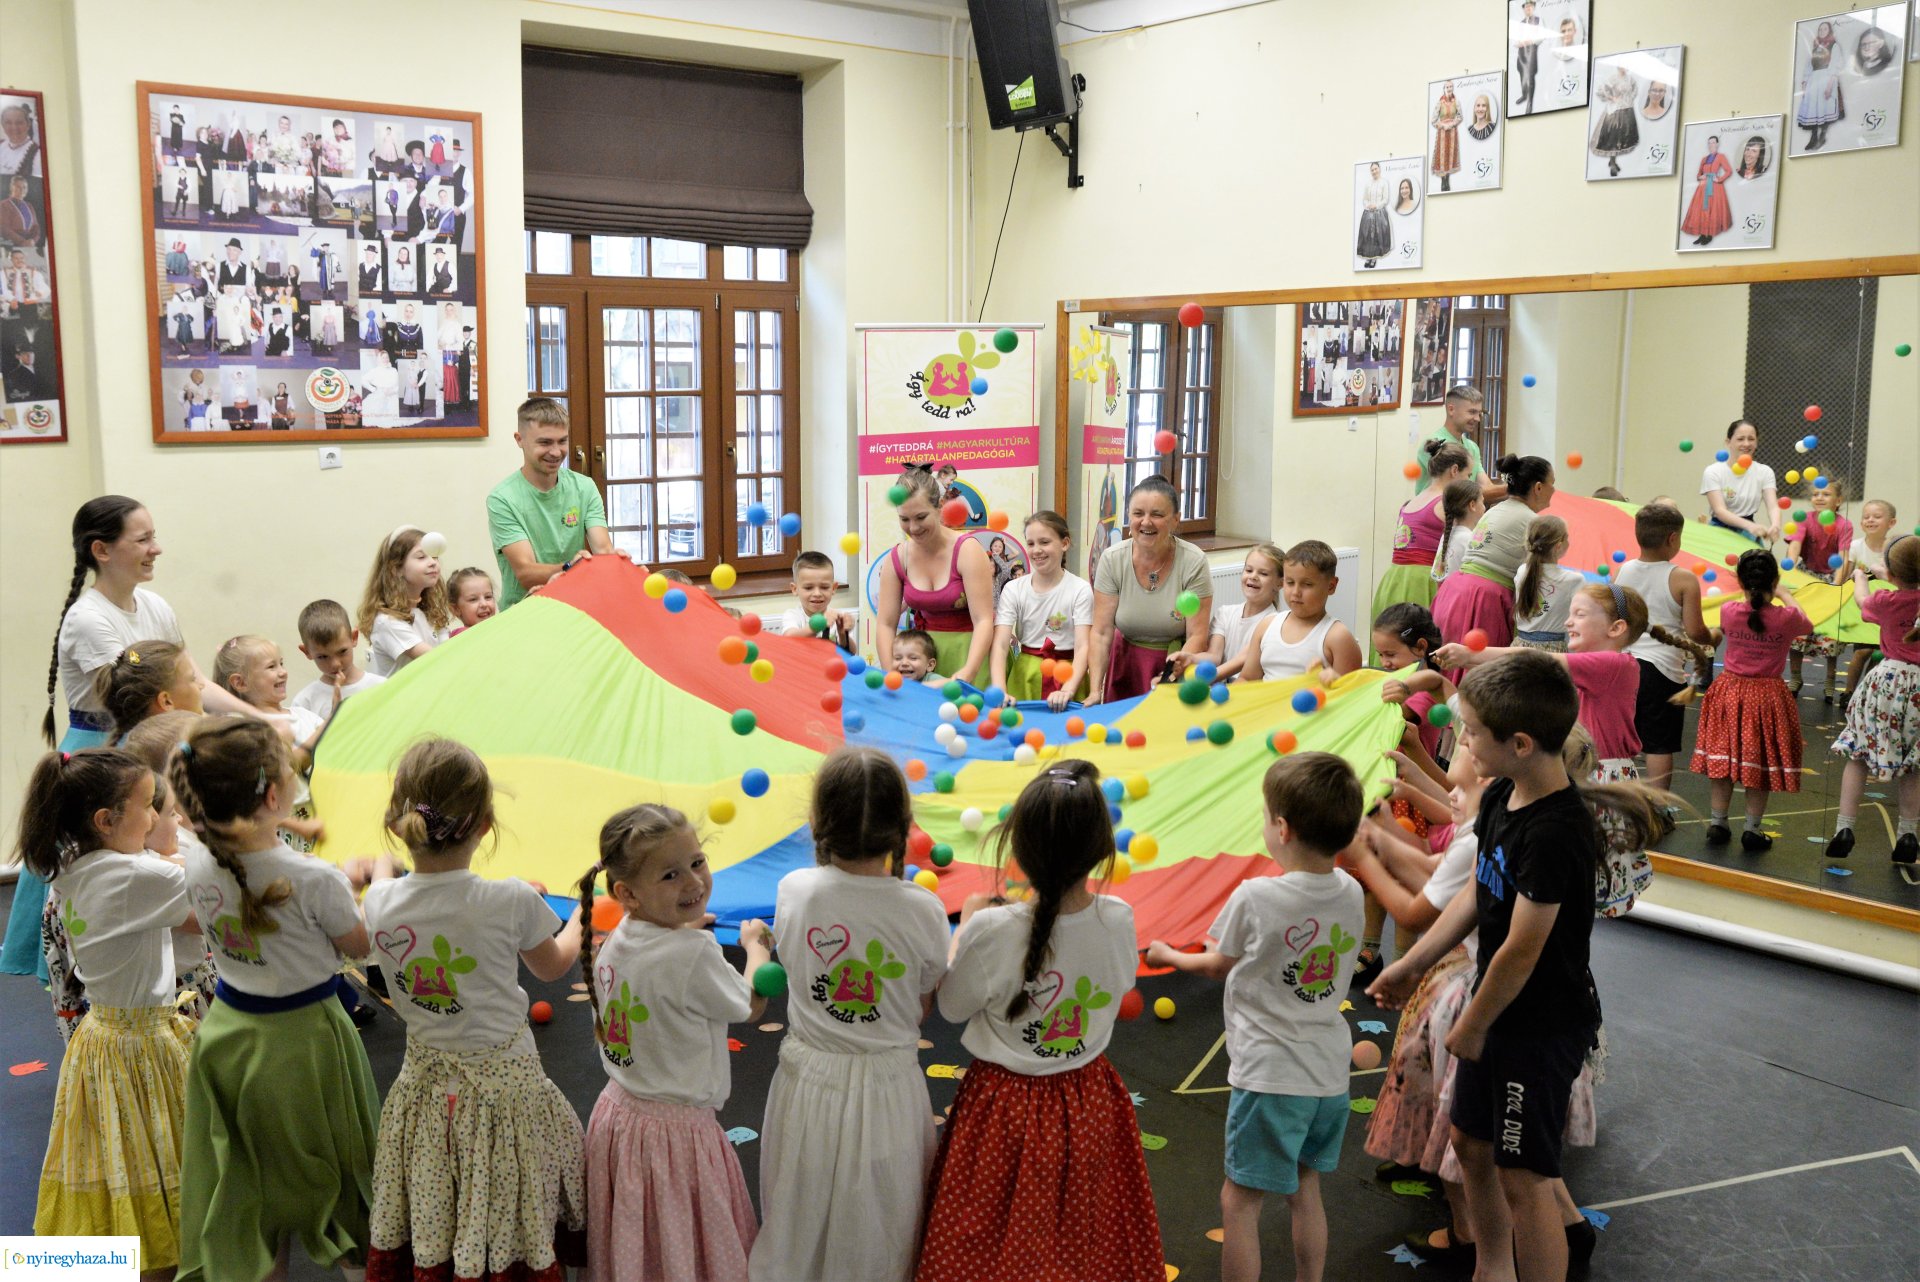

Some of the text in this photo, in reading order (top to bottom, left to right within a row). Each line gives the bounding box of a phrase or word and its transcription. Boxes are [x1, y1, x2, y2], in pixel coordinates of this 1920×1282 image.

[921, 399, 950, 419] tedd
[956, 397, 976, 418] rá!
[869, 436, 1031, 454] #ÍGYTEDDRÁ #MAGYARKULTÚRA
[885, 449, 1016, 465] #HATÁRTALANPEDAGÓGIA
[826, 1004, 855, 1023] tedd
[1502, 1081, 1525, 1155] COOL DUDE
